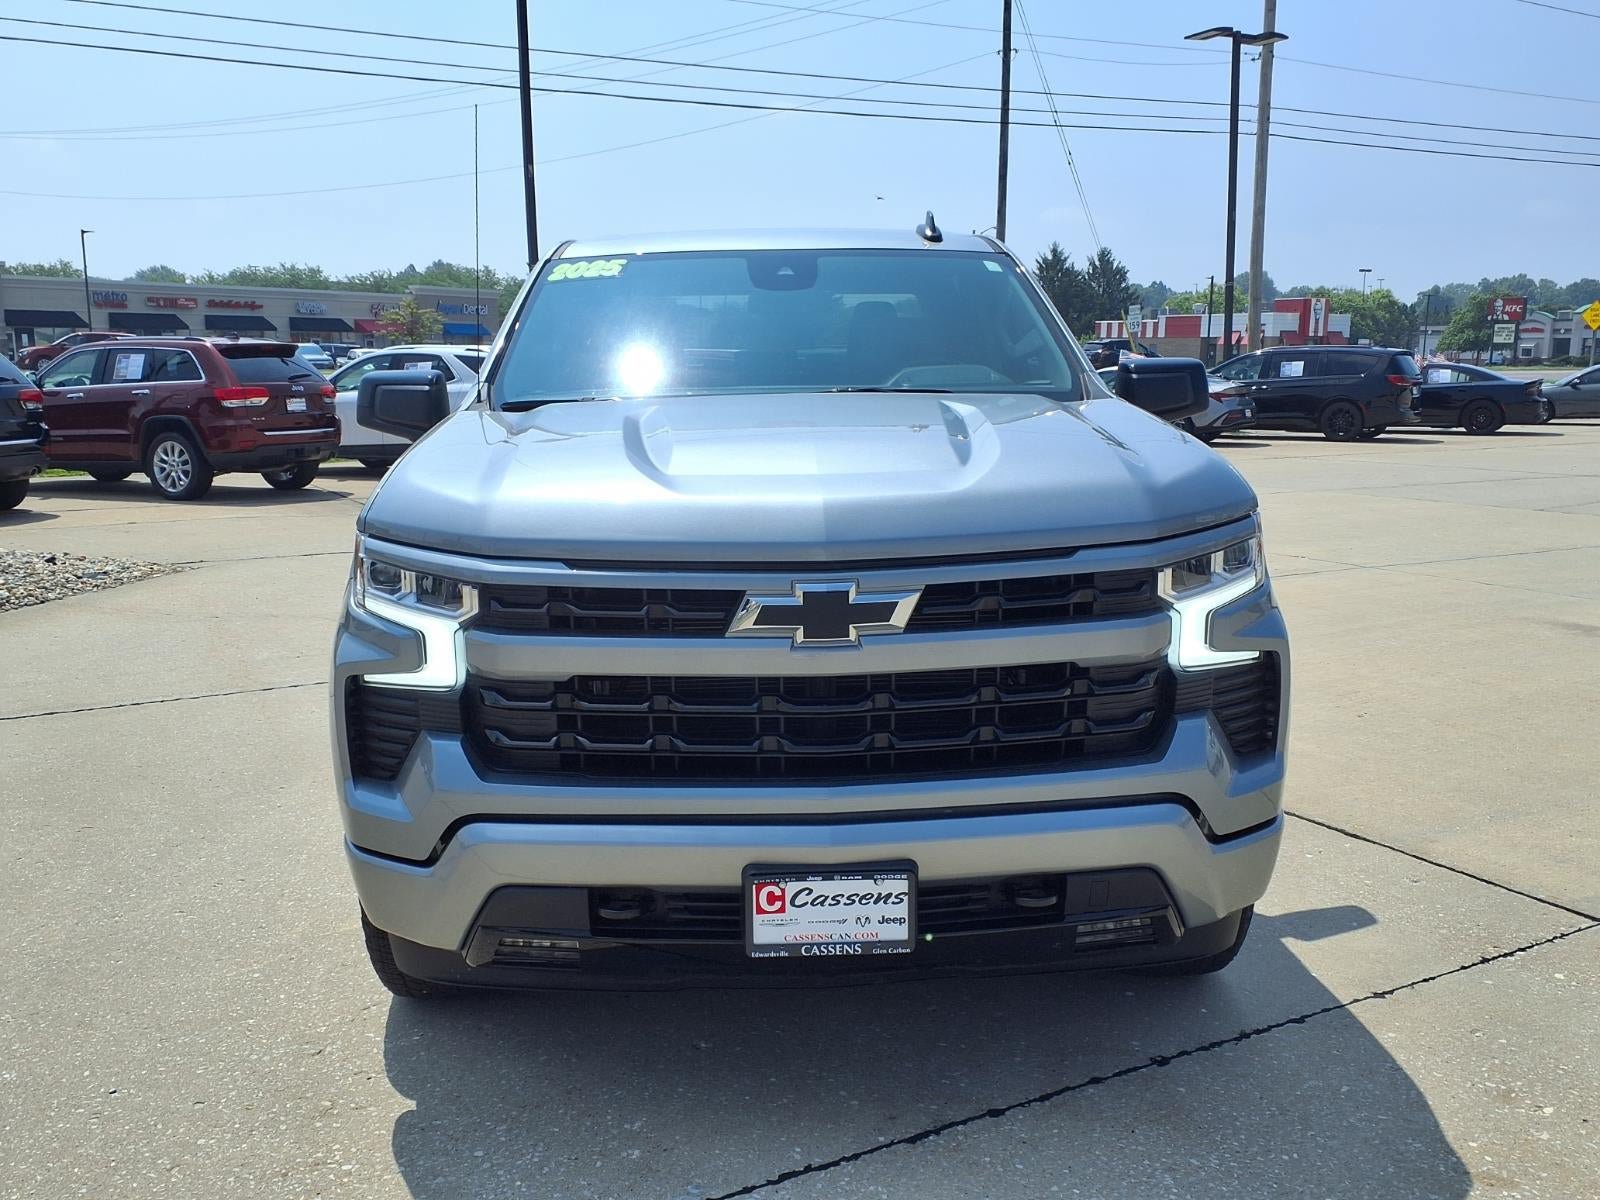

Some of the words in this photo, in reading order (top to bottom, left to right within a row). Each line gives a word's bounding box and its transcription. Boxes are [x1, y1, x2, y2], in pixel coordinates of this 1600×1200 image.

[547, 259, 628, 282] 2025
[1504, 304, 1524, 313] KFC
[1129, 320, 1140, 330] 159
[758, 885, 783, 912] C
[789, 887, 909, 909] Cassens
[877, 915, 907, 926] Jeep
[783, 930, 880, 943] CASSENSCAN.COM
[751, 950, 789, 958] Edwardsville
[800, 943, 862, 957] CASSENS
[872, 947, 888, 955] Glen
[888, 946, 911, 954] Carbon
